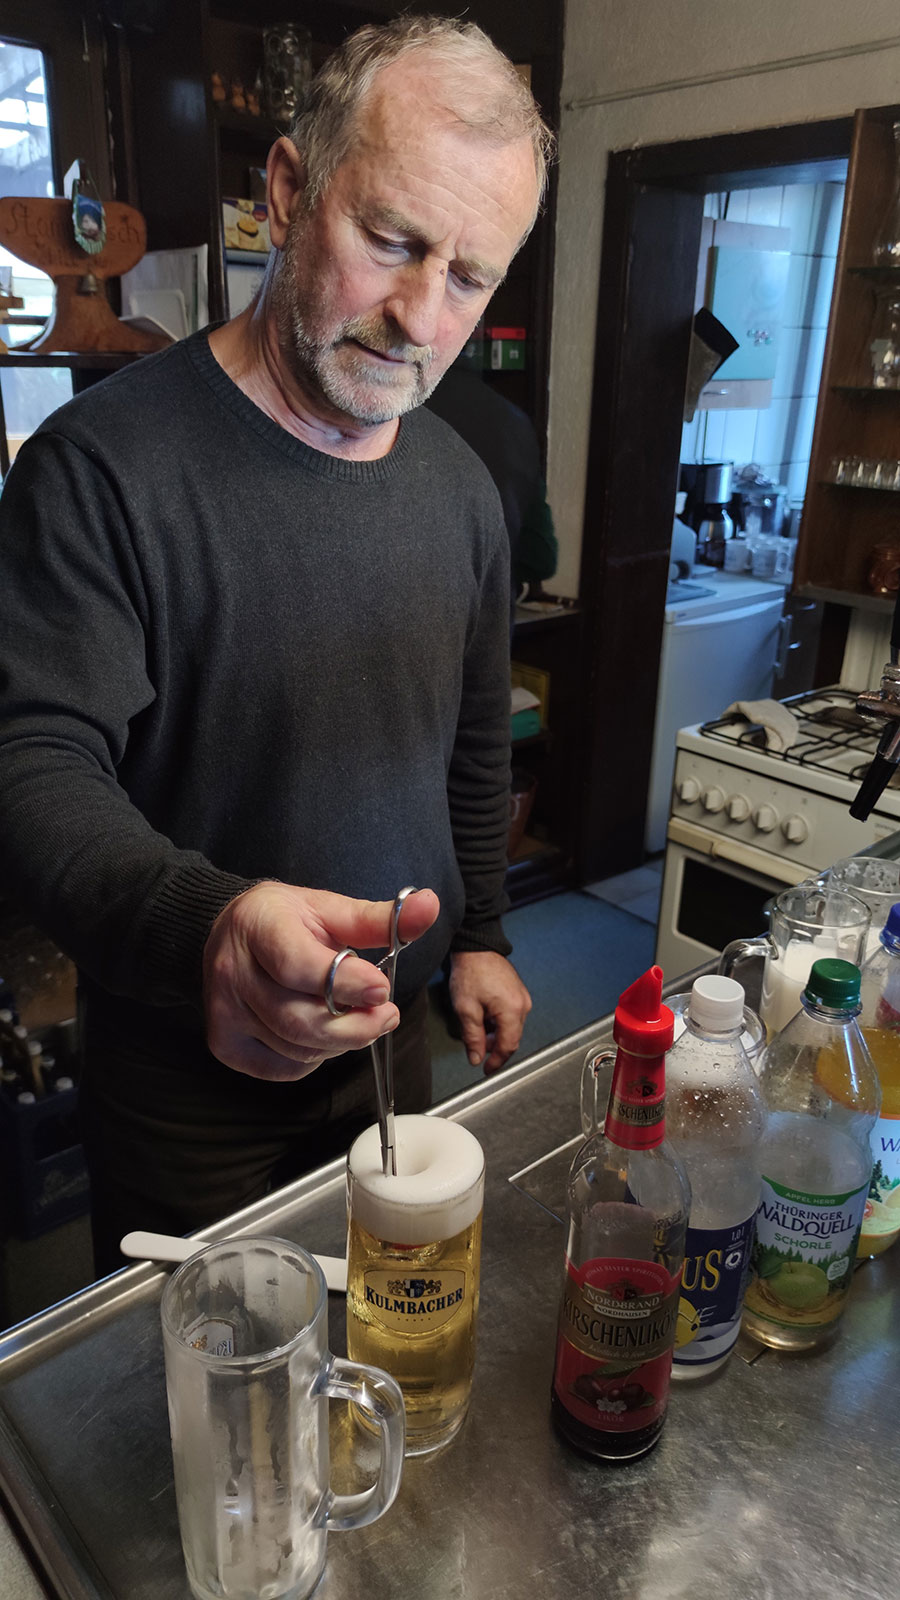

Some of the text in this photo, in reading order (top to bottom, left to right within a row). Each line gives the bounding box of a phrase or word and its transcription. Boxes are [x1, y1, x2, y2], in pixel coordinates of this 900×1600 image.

[785, 1192, 811, 1204] APFEL
[774, 1200, 842, 1221] THÜRINGER
[774, 1232, 832, 1250] SCHORLE
[681, 1249, 722, 1291] US
[366, 1285, 463, 1315] KULMBACHER
[586, 1289, 660, 1311] NORDBRAND
[596, 1305, 648, 1318] NORDHAUSEN
